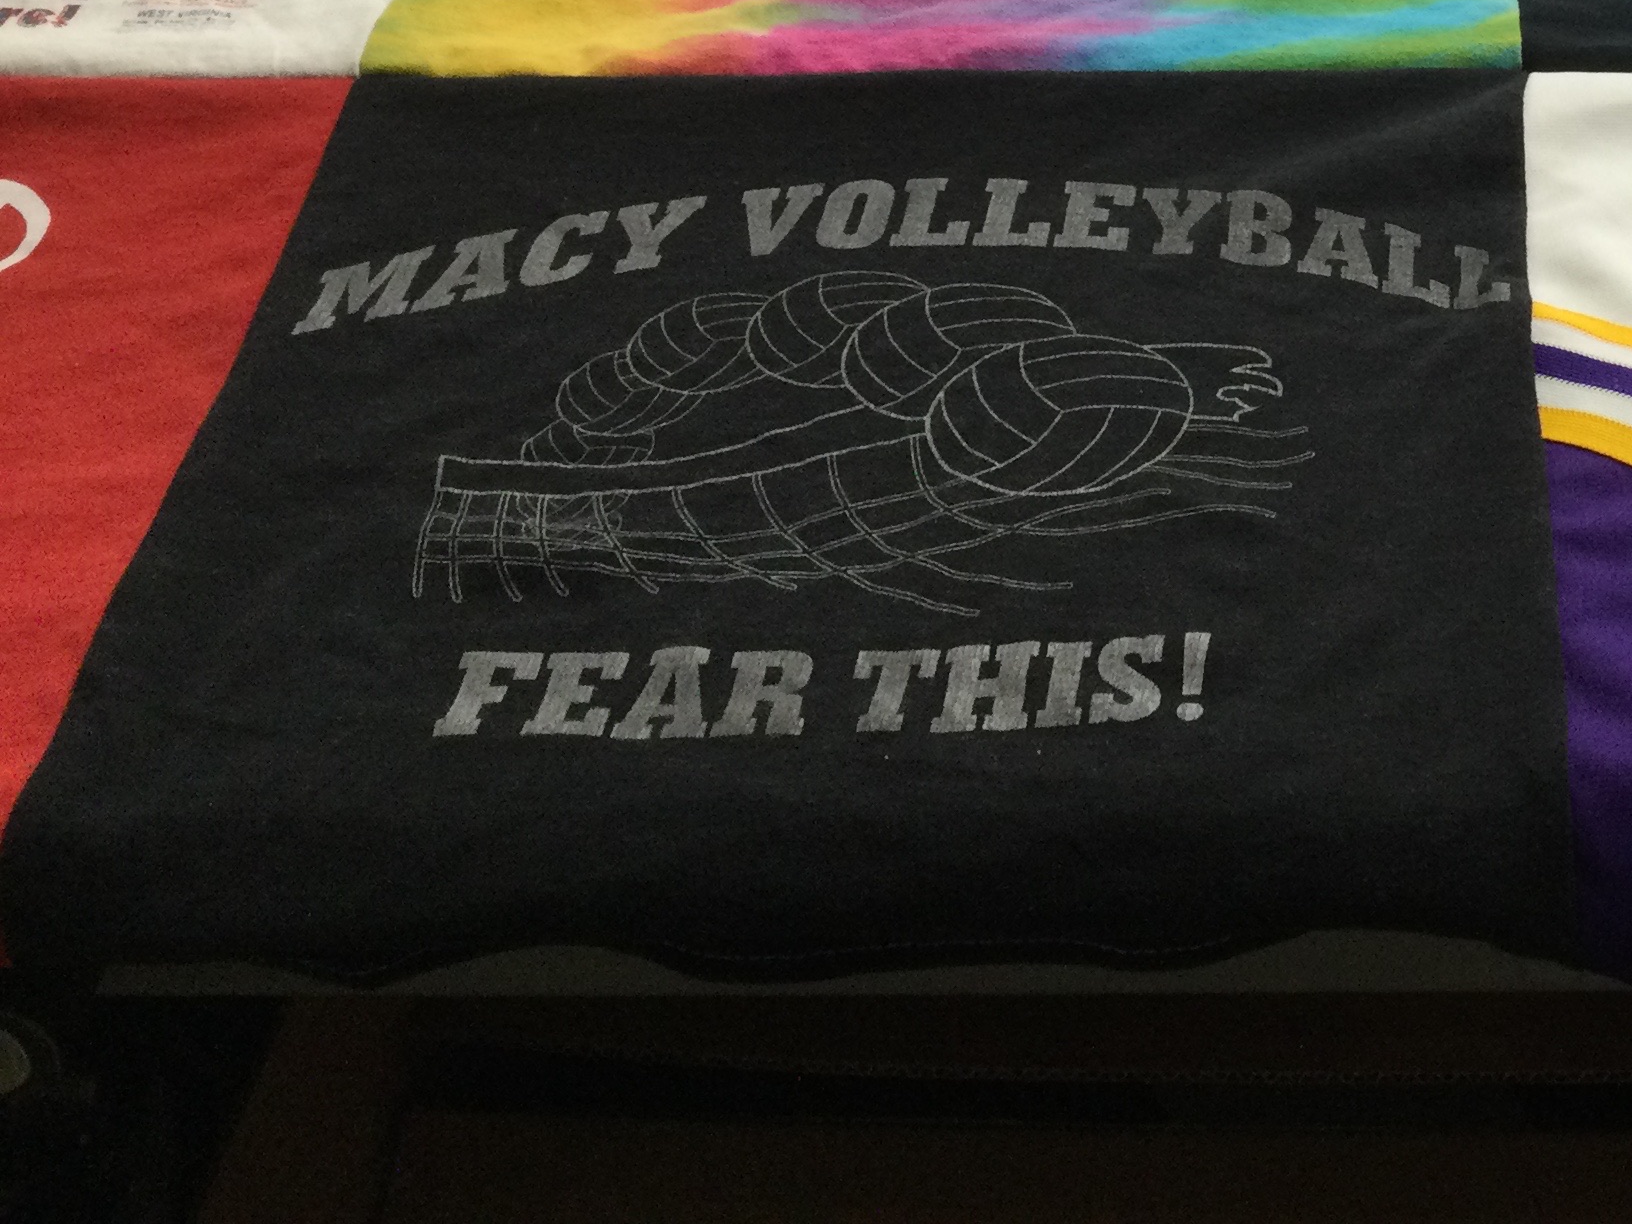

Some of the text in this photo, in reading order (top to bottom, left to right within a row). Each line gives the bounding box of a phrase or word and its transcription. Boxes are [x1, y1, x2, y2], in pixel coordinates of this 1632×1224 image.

[289, 174, 1513, 336] MACY VOLLEYBALL
[431, 631, 1213, 742] FEAR THIS!
